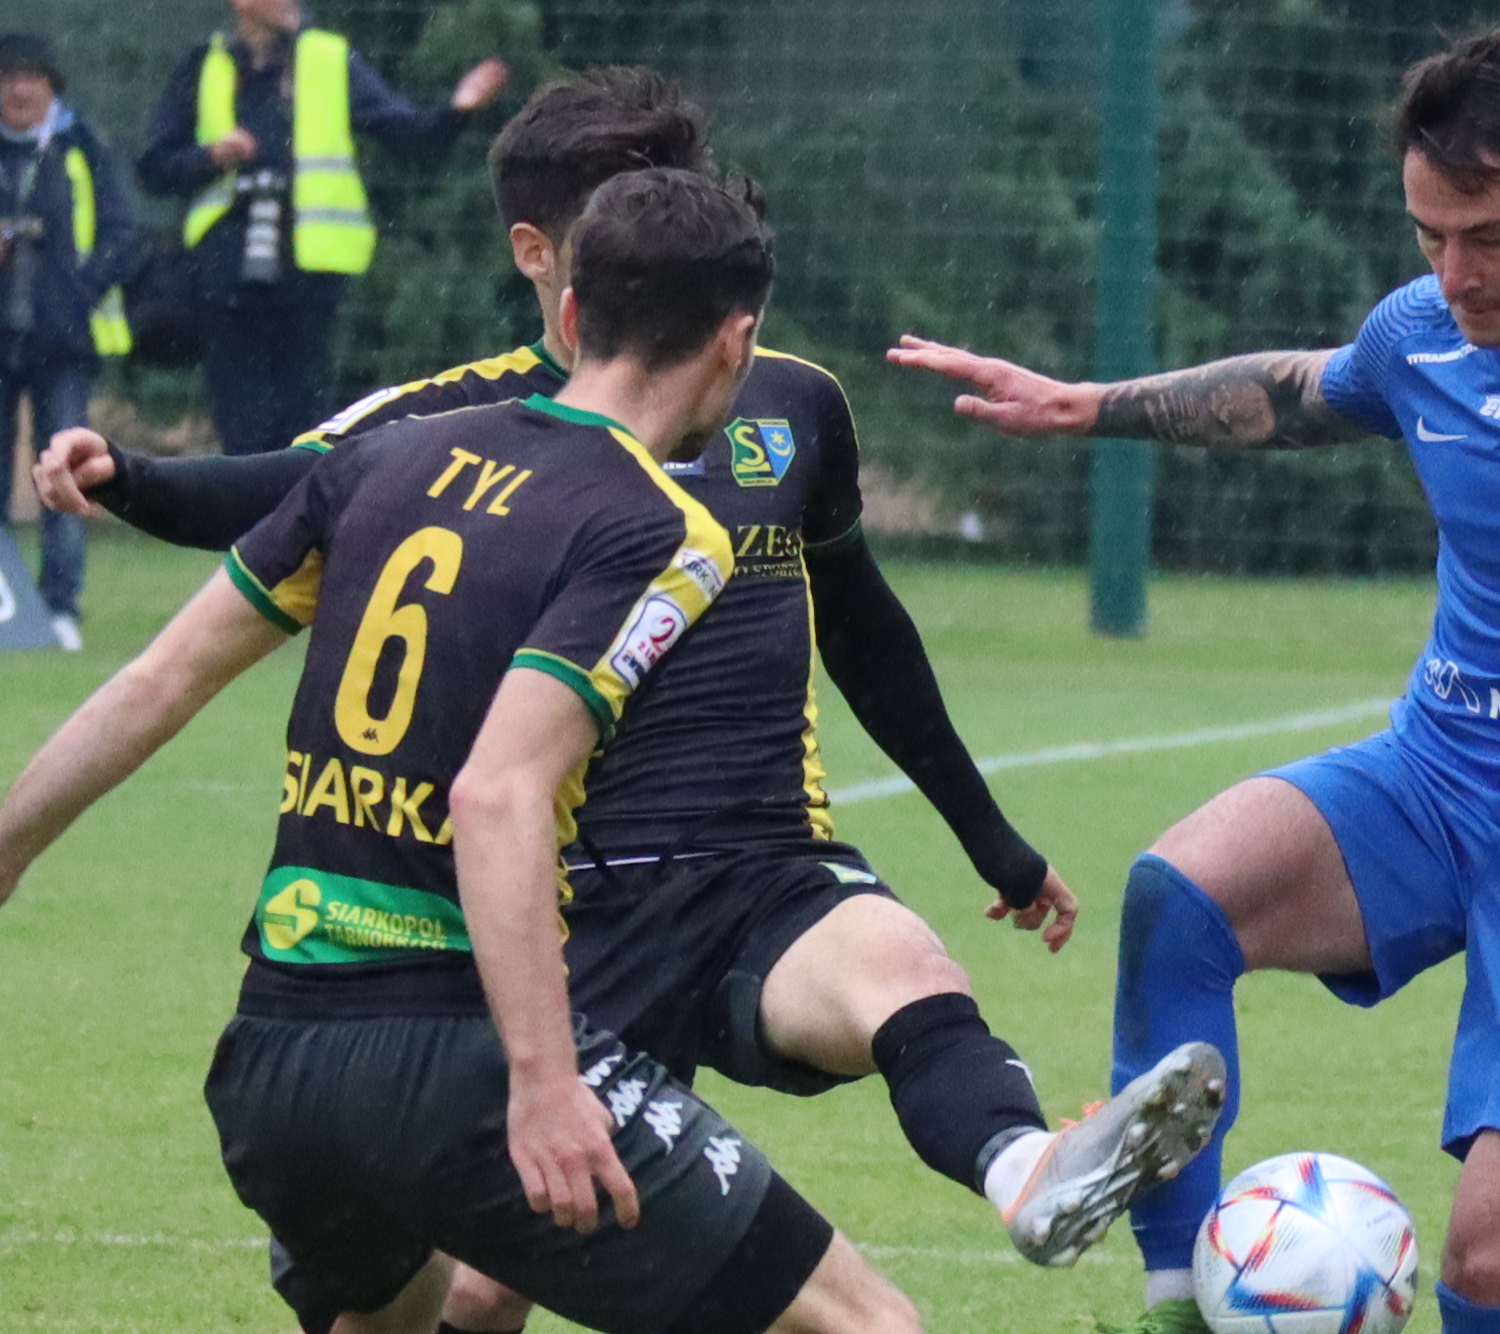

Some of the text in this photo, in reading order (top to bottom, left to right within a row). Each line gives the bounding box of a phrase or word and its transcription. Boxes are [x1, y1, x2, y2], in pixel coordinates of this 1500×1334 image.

[426, 447, 533, 517] TYL
[334, 525, 463, 757] 6
[280, 750, 453, 846] SIARK
